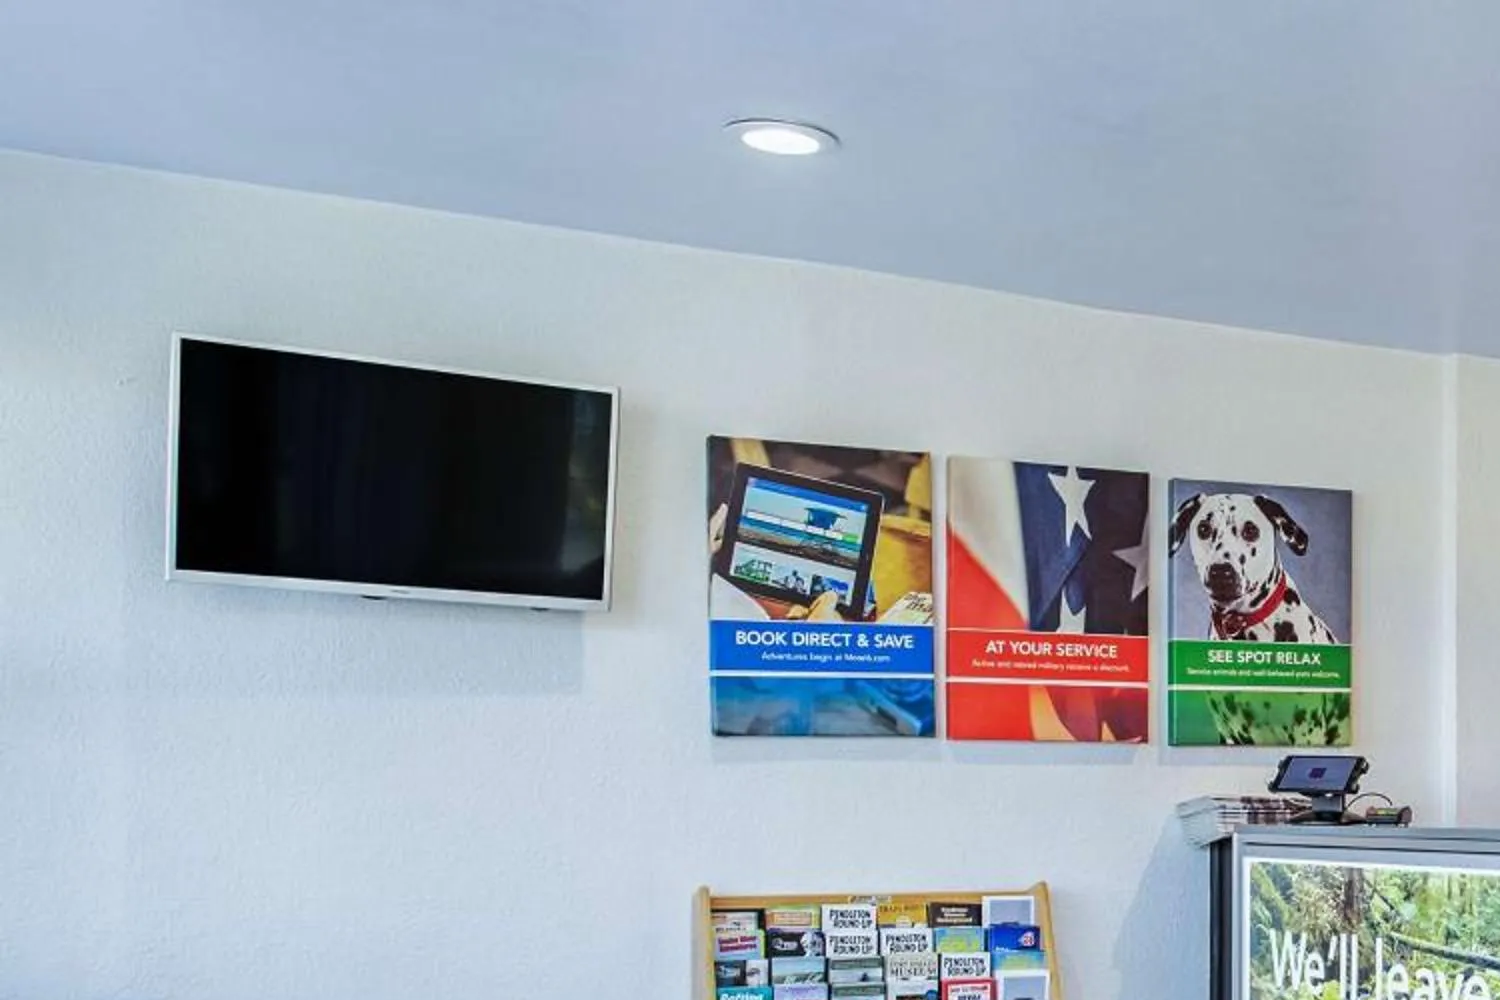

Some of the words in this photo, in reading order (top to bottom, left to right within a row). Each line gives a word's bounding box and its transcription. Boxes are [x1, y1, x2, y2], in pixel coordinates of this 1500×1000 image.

[735, 630, 787, 646] BOOK
[792, 632, 852, 647] DIRECT
[857, 632, 869, 648] &
[874, 634, 915, 649] SAVE
[985, 639, 1006, 654] AT
[1010, 640, 1052, 656] YOUR
[1056, 643, 1118, 659] SERVICE
[761, 651, 808, 662] Adventures
[1207, 649, 1233, 664] SEE
[1237, 651, 1273, 664] SPOT
[1276, 652, 1321, 666] RELAX
[829, 909, 871, 920] PENDLETON
[829, 935, 871, 946] PENDLETON
[886, 933, 927, 945] PENDLETON
[943, 957, 985, 968] PENDLETON
[1268, 928, 1359, 1000] We'll
